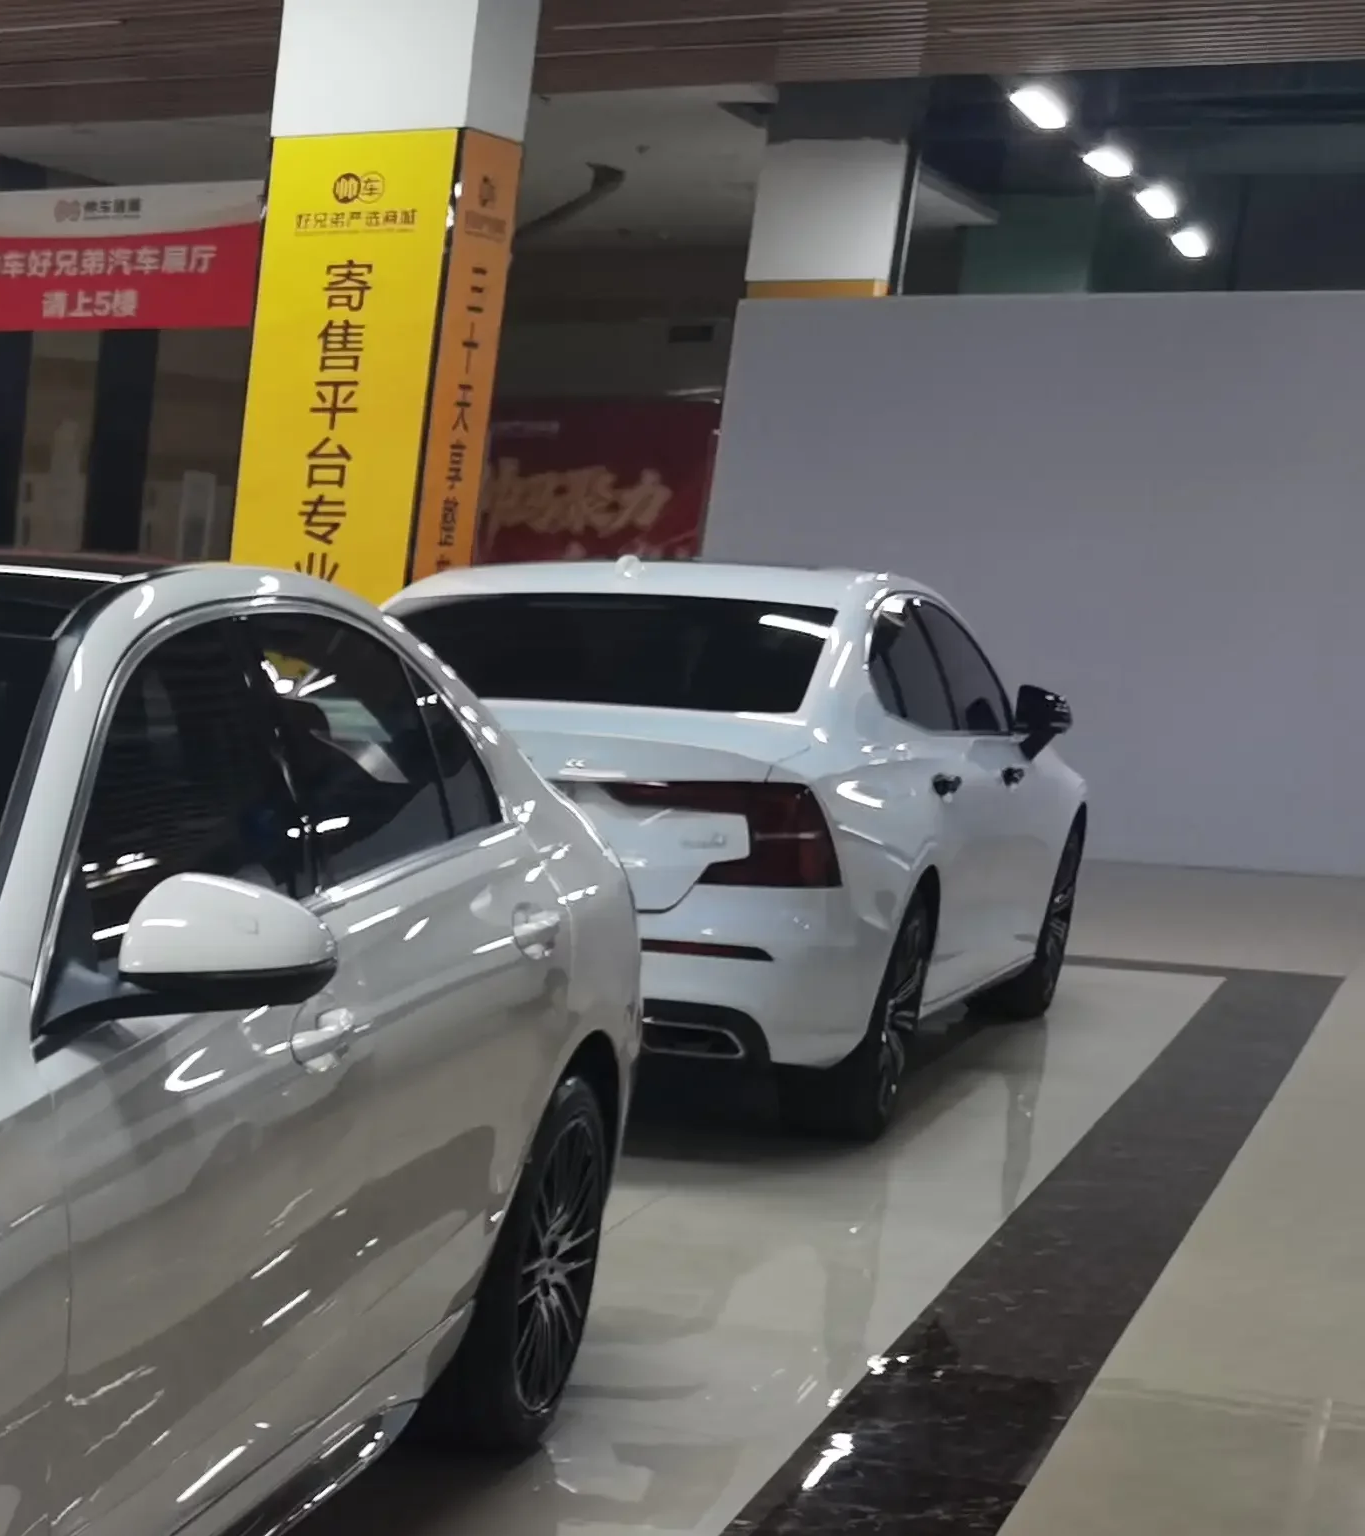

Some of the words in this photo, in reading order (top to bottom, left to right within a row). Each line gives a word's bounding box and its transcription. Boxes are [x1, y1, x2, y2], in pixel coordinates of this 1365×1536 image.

[296, 208, 417, 230] 好兄弟严选商城
[294, 259, 373, 583] 寄售平台专业
